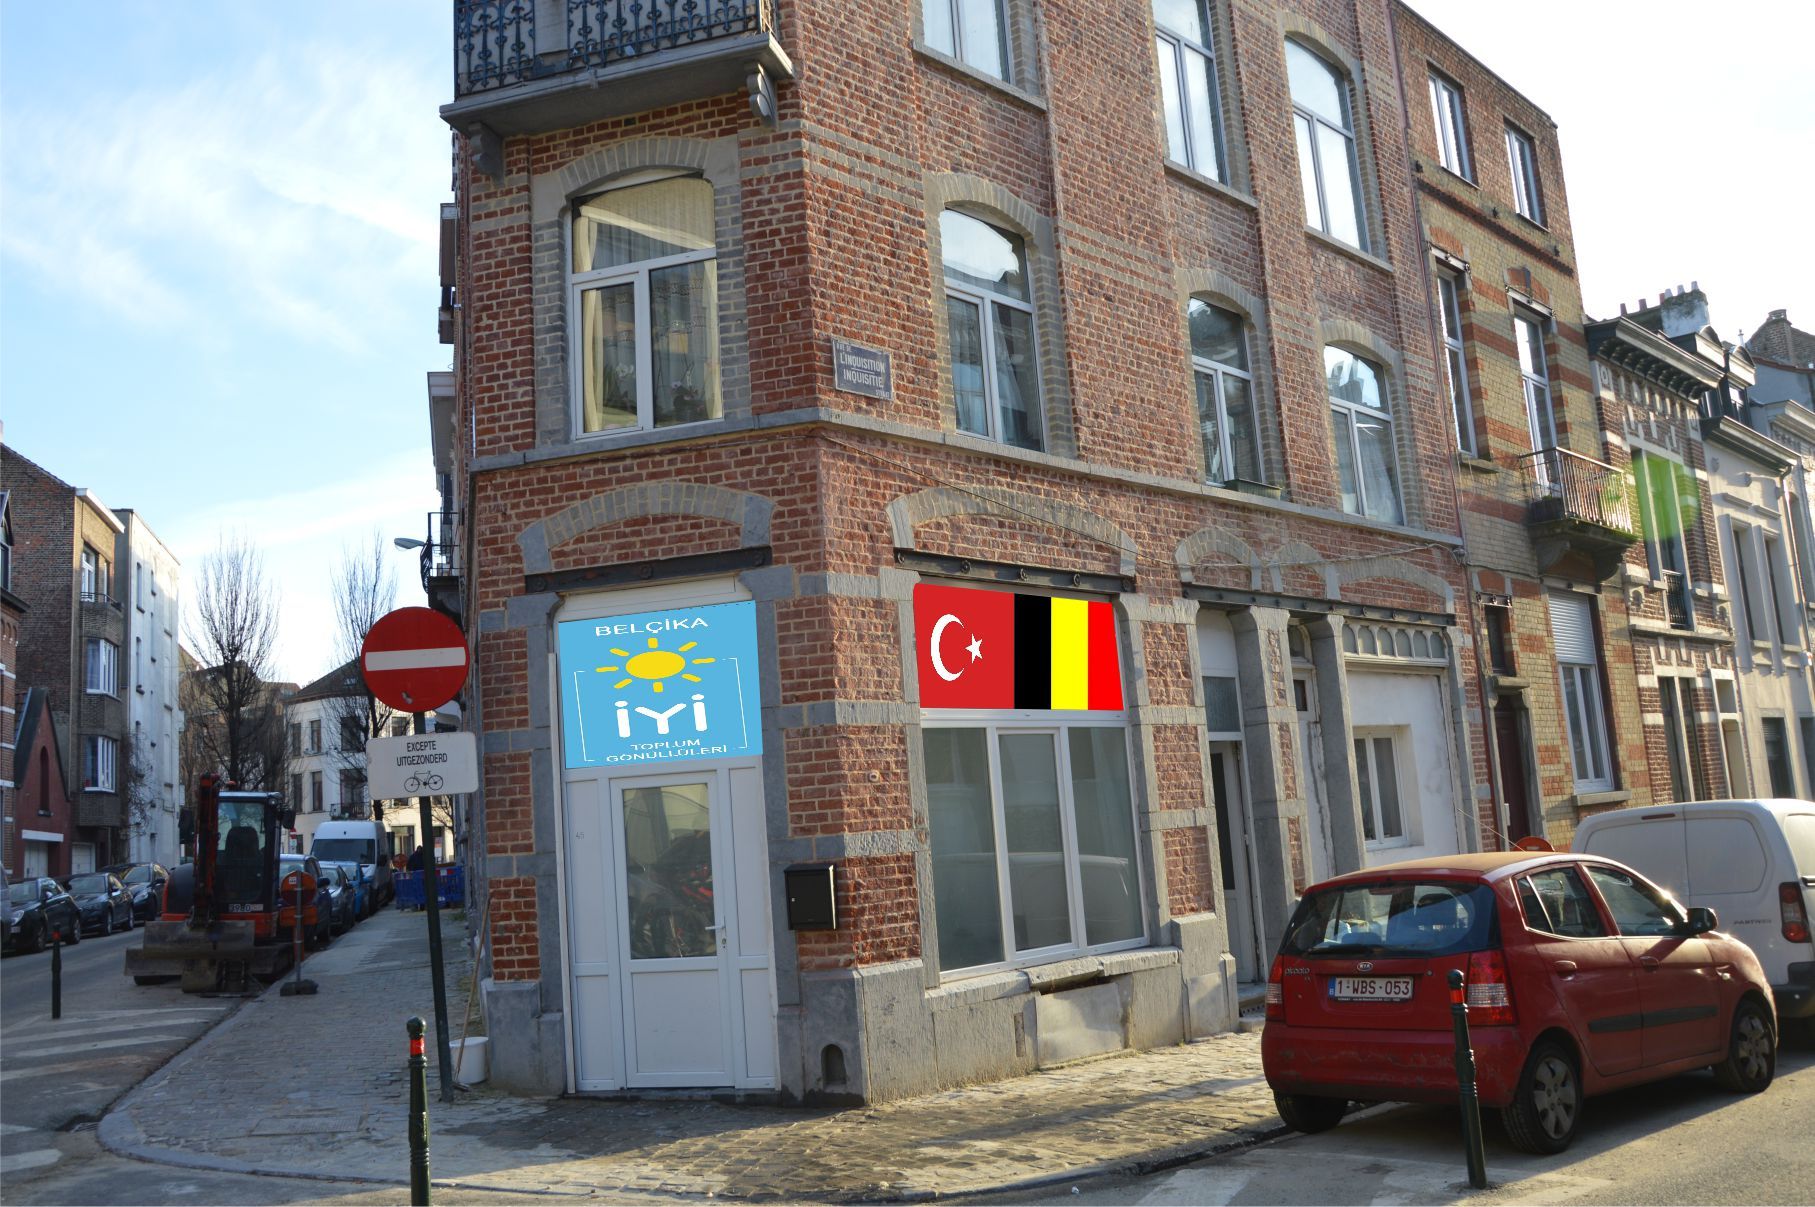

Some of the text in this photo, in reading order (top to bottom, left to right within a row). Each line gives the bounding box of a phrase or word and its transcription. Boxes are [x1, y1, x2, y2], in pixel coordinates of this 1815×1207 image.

[843, 369, 884, 389] INQUISITIE
[406, 740, 437, 752] EXCEPTE
[630, 739, 701, 751] TOPLUM
[396, 753, 448, 767] UITGEZONDERD
